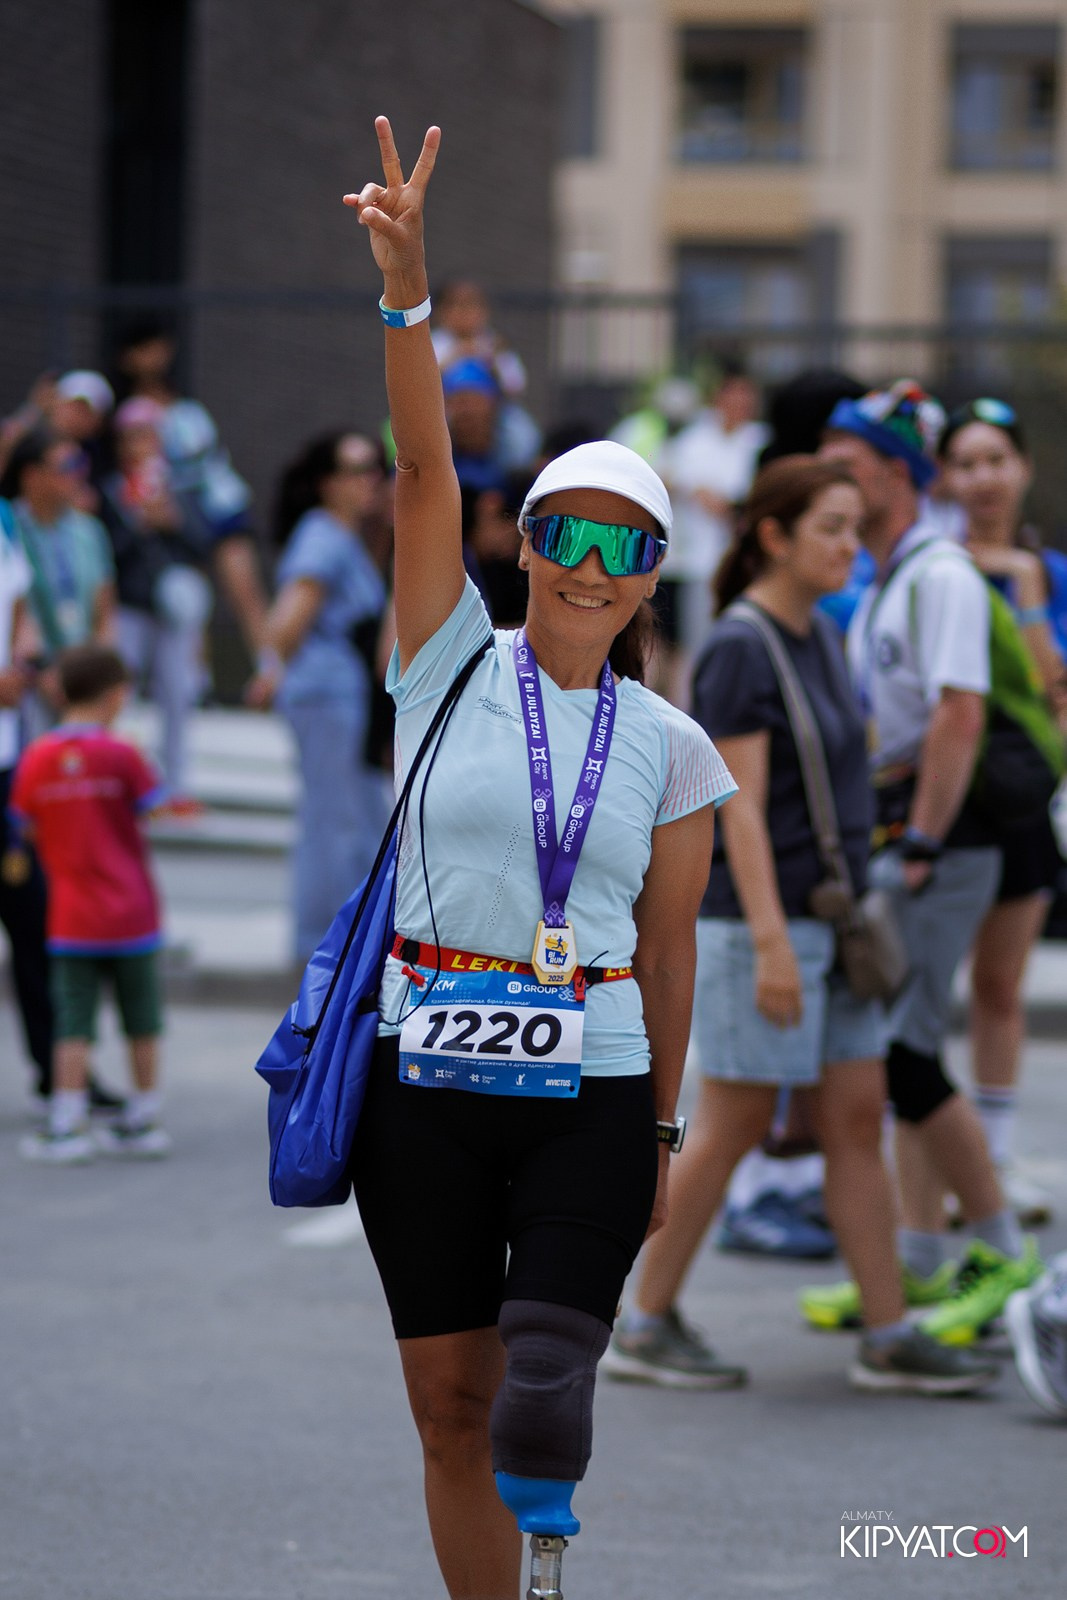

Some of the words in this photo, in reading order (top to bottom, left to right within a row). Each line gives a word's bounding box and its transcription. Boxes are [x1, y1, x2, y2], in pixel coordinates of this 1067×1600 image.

[517, 648, 528, 664] City
[524, 682, 534, 692] BI
[526, 694, 541, 739] JULDYZAI
[593, 711, 609, 752] JULDYZAI
[535, 800, 545, 811] BI
[572, 806, 583, 817] BI
[536, 814, 547, 848] GROUP
[563, 819, 578, 852] GROUP
[451, 954, 518, 973] LEKI
[549, 957, 564, 965] RUN
[431, 980, 457, 992] KM
[523, 984, 558, 994] GROUP
[421, 1010, 562, 1057] 1220
